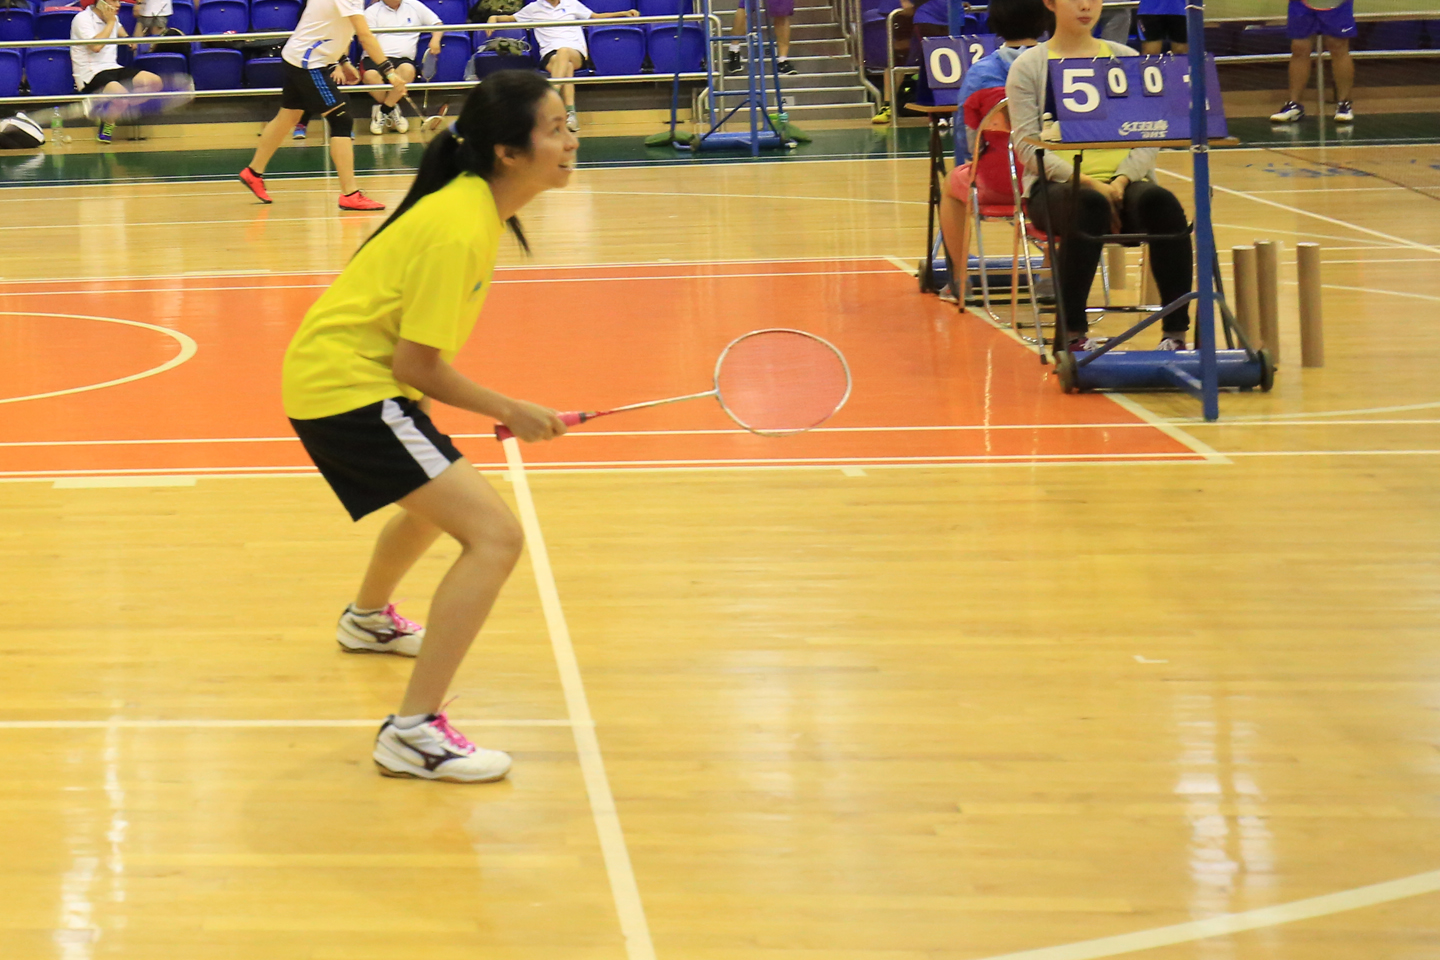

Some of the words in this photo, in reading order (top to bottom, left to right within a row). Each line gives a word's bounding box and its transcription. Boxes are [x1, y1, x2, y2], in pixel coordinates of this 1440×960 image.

[929, 47, 962, 84] 0
[969, 43, 984, 64] 2
[1062, 68, 1100, 113] 5
[1107, 68, 1128, 94] 0
[1143, 66, 1163, 93] 0
